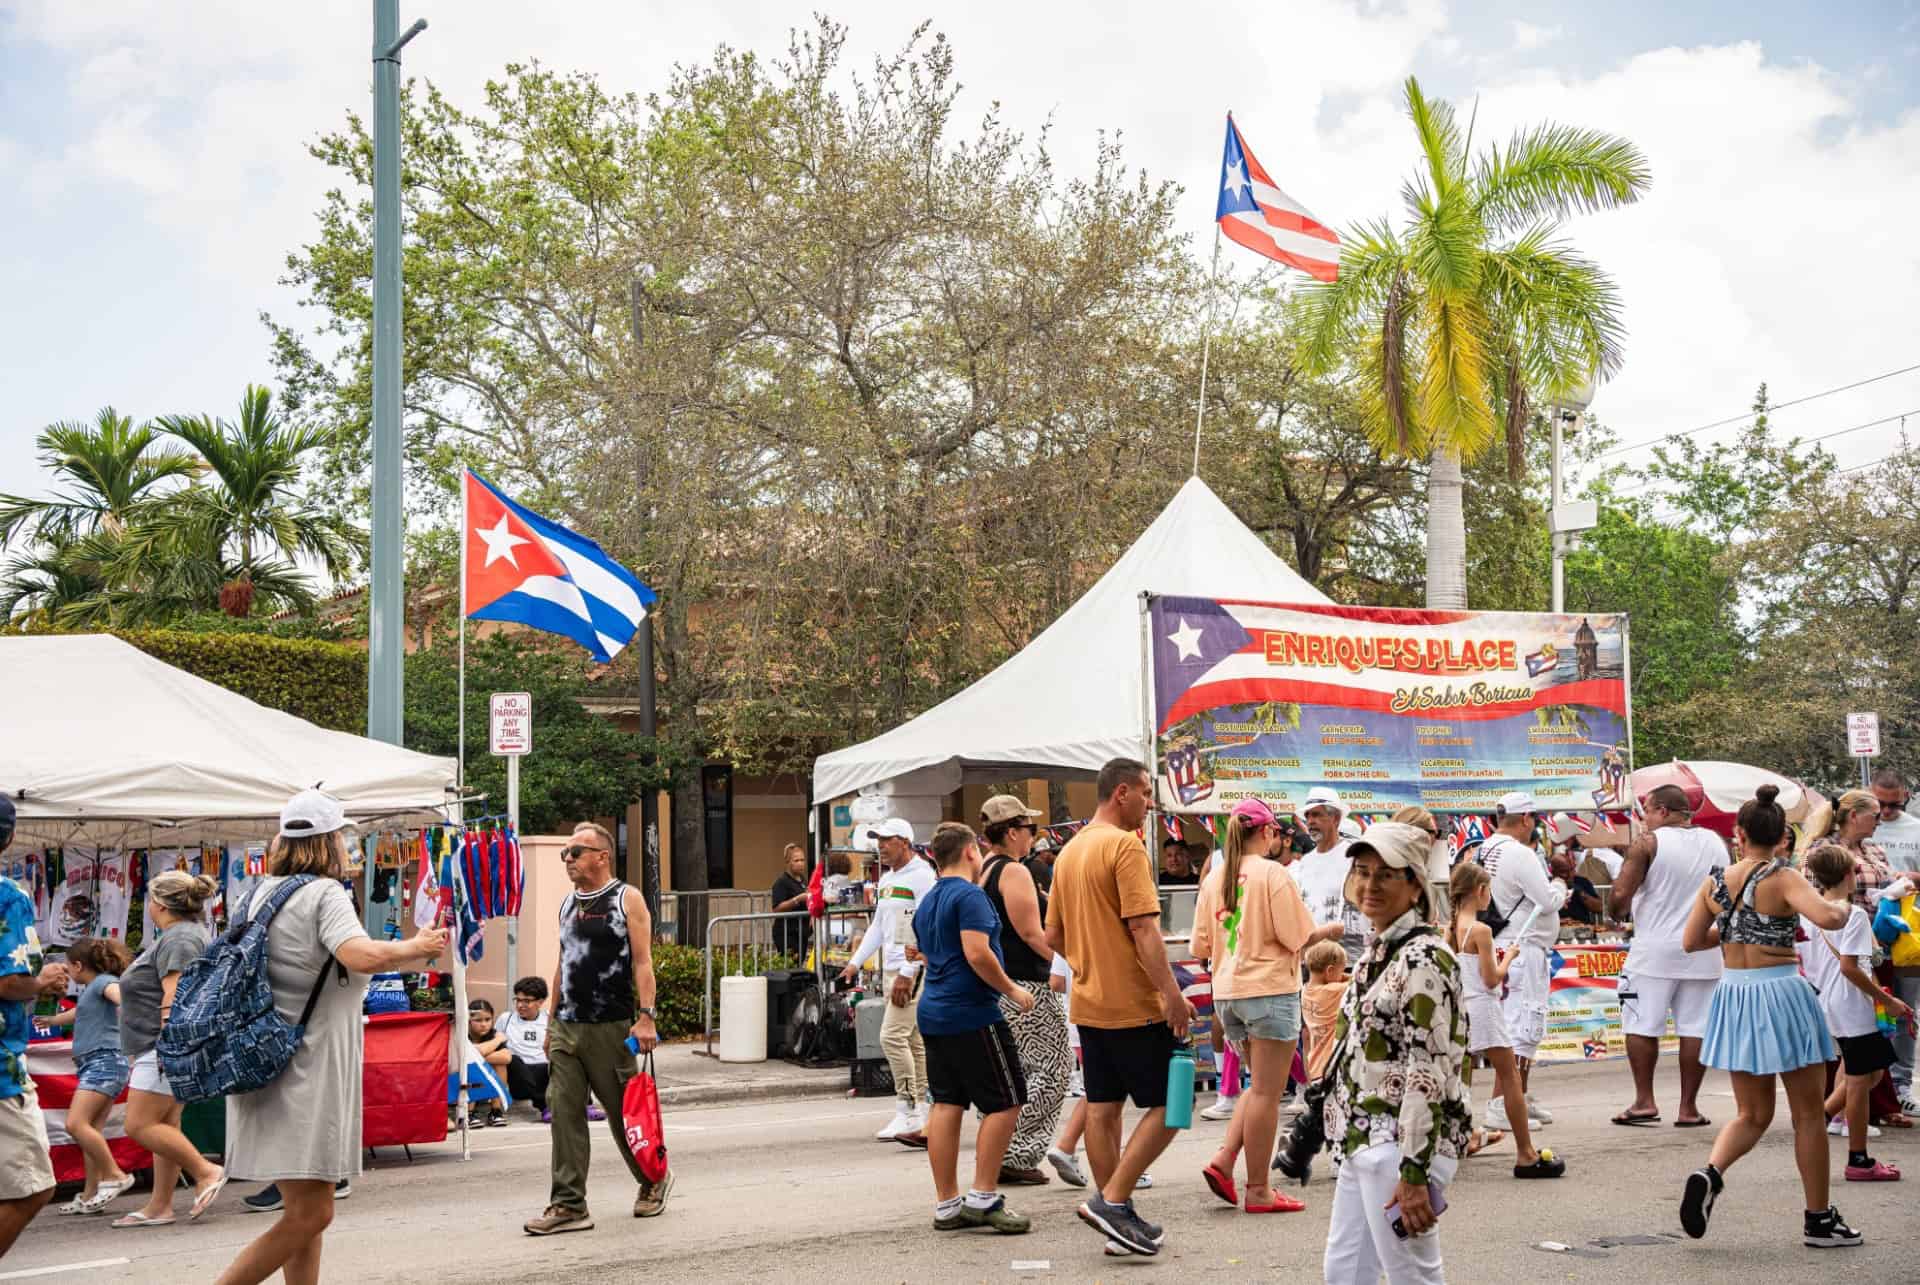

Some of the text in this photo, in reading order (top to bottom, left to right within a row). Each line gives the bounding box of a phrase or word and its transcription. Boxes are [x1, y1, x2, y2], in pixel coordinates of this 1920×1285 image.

[1264, 632, 1516, 673] ENRIQUE'S PLACE
[1391, 682, 1533, 712] El Sabor Boricua
[504, 698, 518, 708] NO
[495, 708, 528, 718] PARKING
[503, 718, 519, 727] ANY
[500, 728, 521, 738] TIME
[1357, 770, 1370, 779] THE
[1371, 770, 1390, 779] GRILL
[1263, 791, 1288, 800] POLLO
